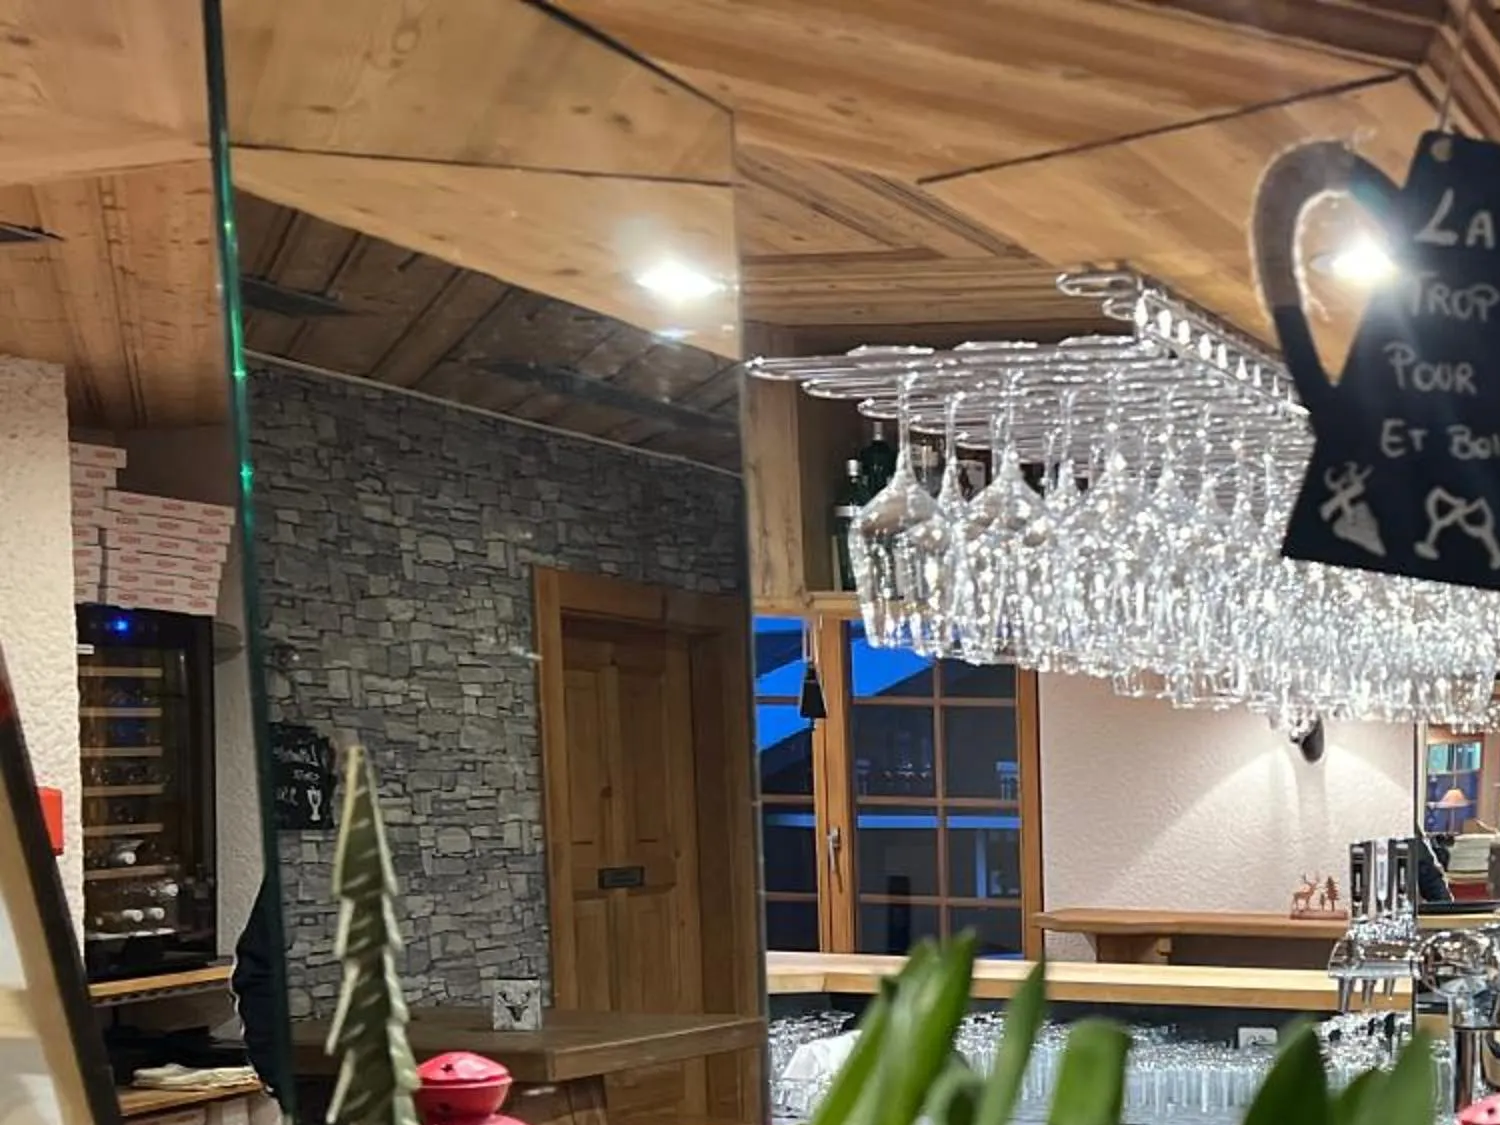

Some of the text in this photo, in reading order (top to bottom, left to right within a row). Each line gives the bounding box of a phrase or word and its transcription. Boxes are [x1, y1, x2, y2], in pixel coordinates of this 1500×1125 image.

[1415, 188, 1495, 248] LA
[1405, 269, 1499, 322] TROP
[1383, 341, 1477, 394] POUR
[1380, 418, 1428, 457] ET
